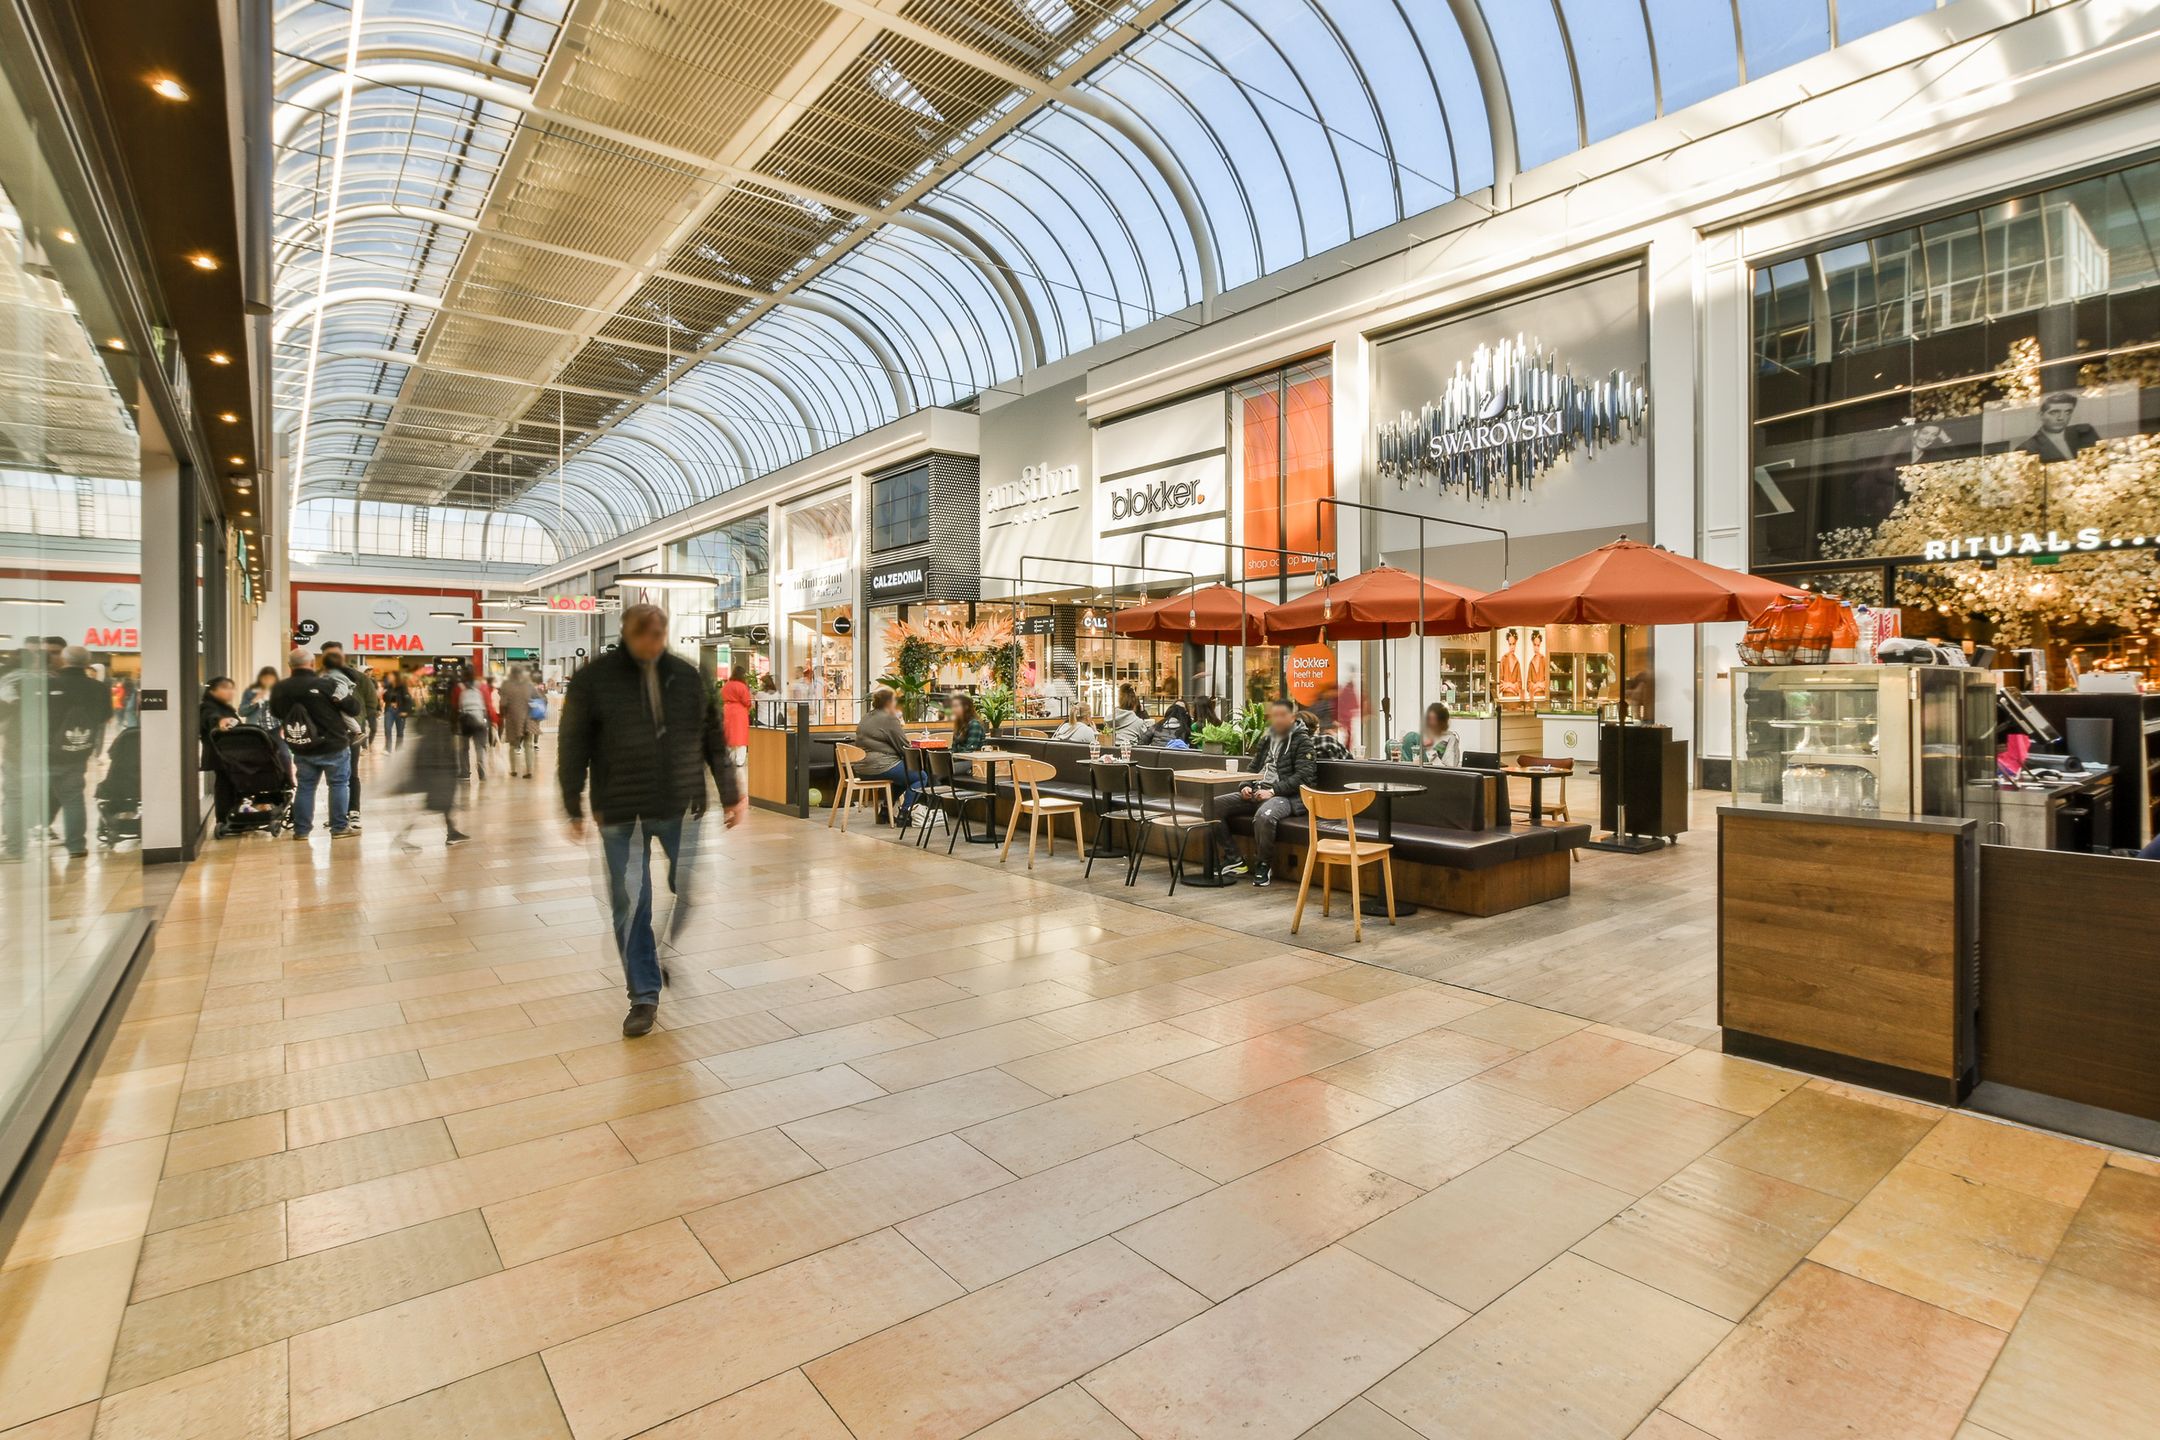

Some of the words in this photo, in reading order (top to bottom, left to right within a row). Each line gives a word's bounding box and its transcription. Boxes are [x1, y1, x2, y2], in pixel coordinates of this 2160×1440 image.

[1429, 411, 1563, 458] SWAROVSKI
[1111, 479, 1206, 521] blokker.
[1248, 559, 1268, 570] shop
[1287, 555, 1300, 566] op
[873, 569, 923, 589] CALZEDONIA
[353, 633, 424, 651] HEMA
[1294, 670, 1311, 679] heeft
[1312, 670, 1324, 679] het
[1294, 680, 1300, 688] in
[1301, 680, 1315, 688] huis
